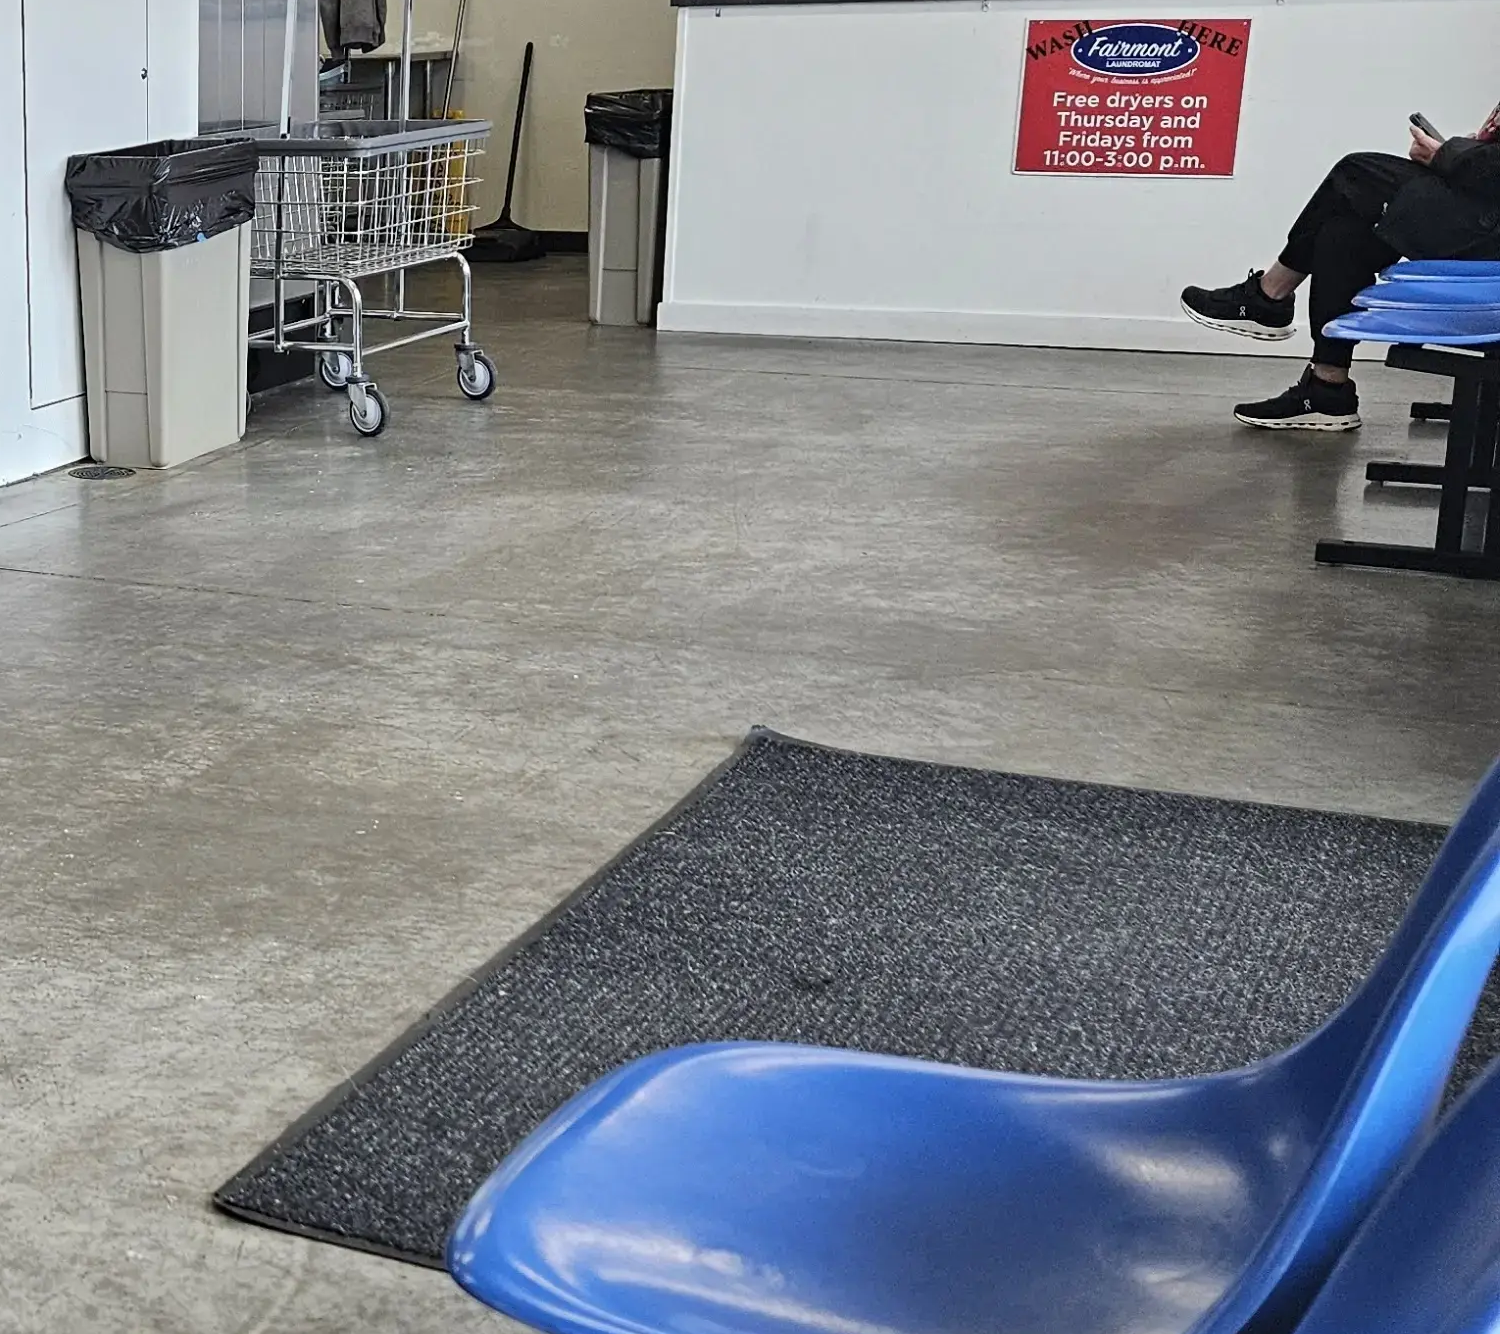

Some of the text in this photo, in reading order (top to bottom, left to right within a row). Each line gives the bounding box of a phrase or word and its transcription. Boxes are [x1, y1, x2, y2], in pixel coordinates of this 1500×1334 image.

[1027, 20, 1243, 61] WASH HERE
[1088, 37, 1184, 57] Fairmont
[1106, 60, 1161, 68] LAUNDROMAT
[1053, 91, 1208, 110] Free dryers on
[1057, 111, 1200, 131] Thursday and
[1058, 131, 1193, 149] Fridays from
[1043, 150, 1206, 171] 11:00-3:00 p.m.
